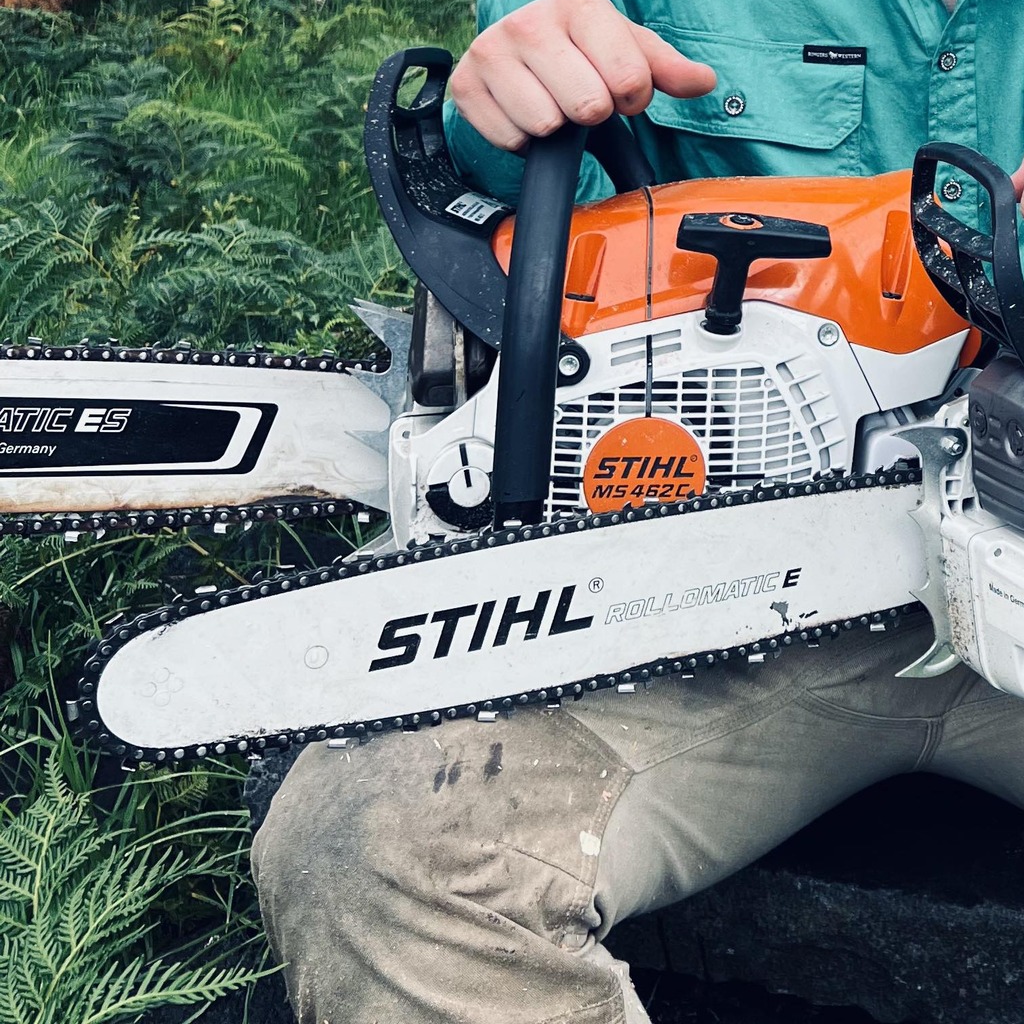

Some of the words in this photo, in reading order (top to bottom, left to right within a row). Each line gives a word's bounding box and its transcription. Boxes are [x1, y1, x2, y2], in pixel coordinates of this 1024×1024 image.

[74, 408, 132, 433] ES
[0, 442, 57, 456] Germany
[592, 485, 630, 499] MS
[604, 571, 781, 625] ROLLOMATIC
[781, 568, 802, 589] E
[988, 581, 1003, 597] Made
